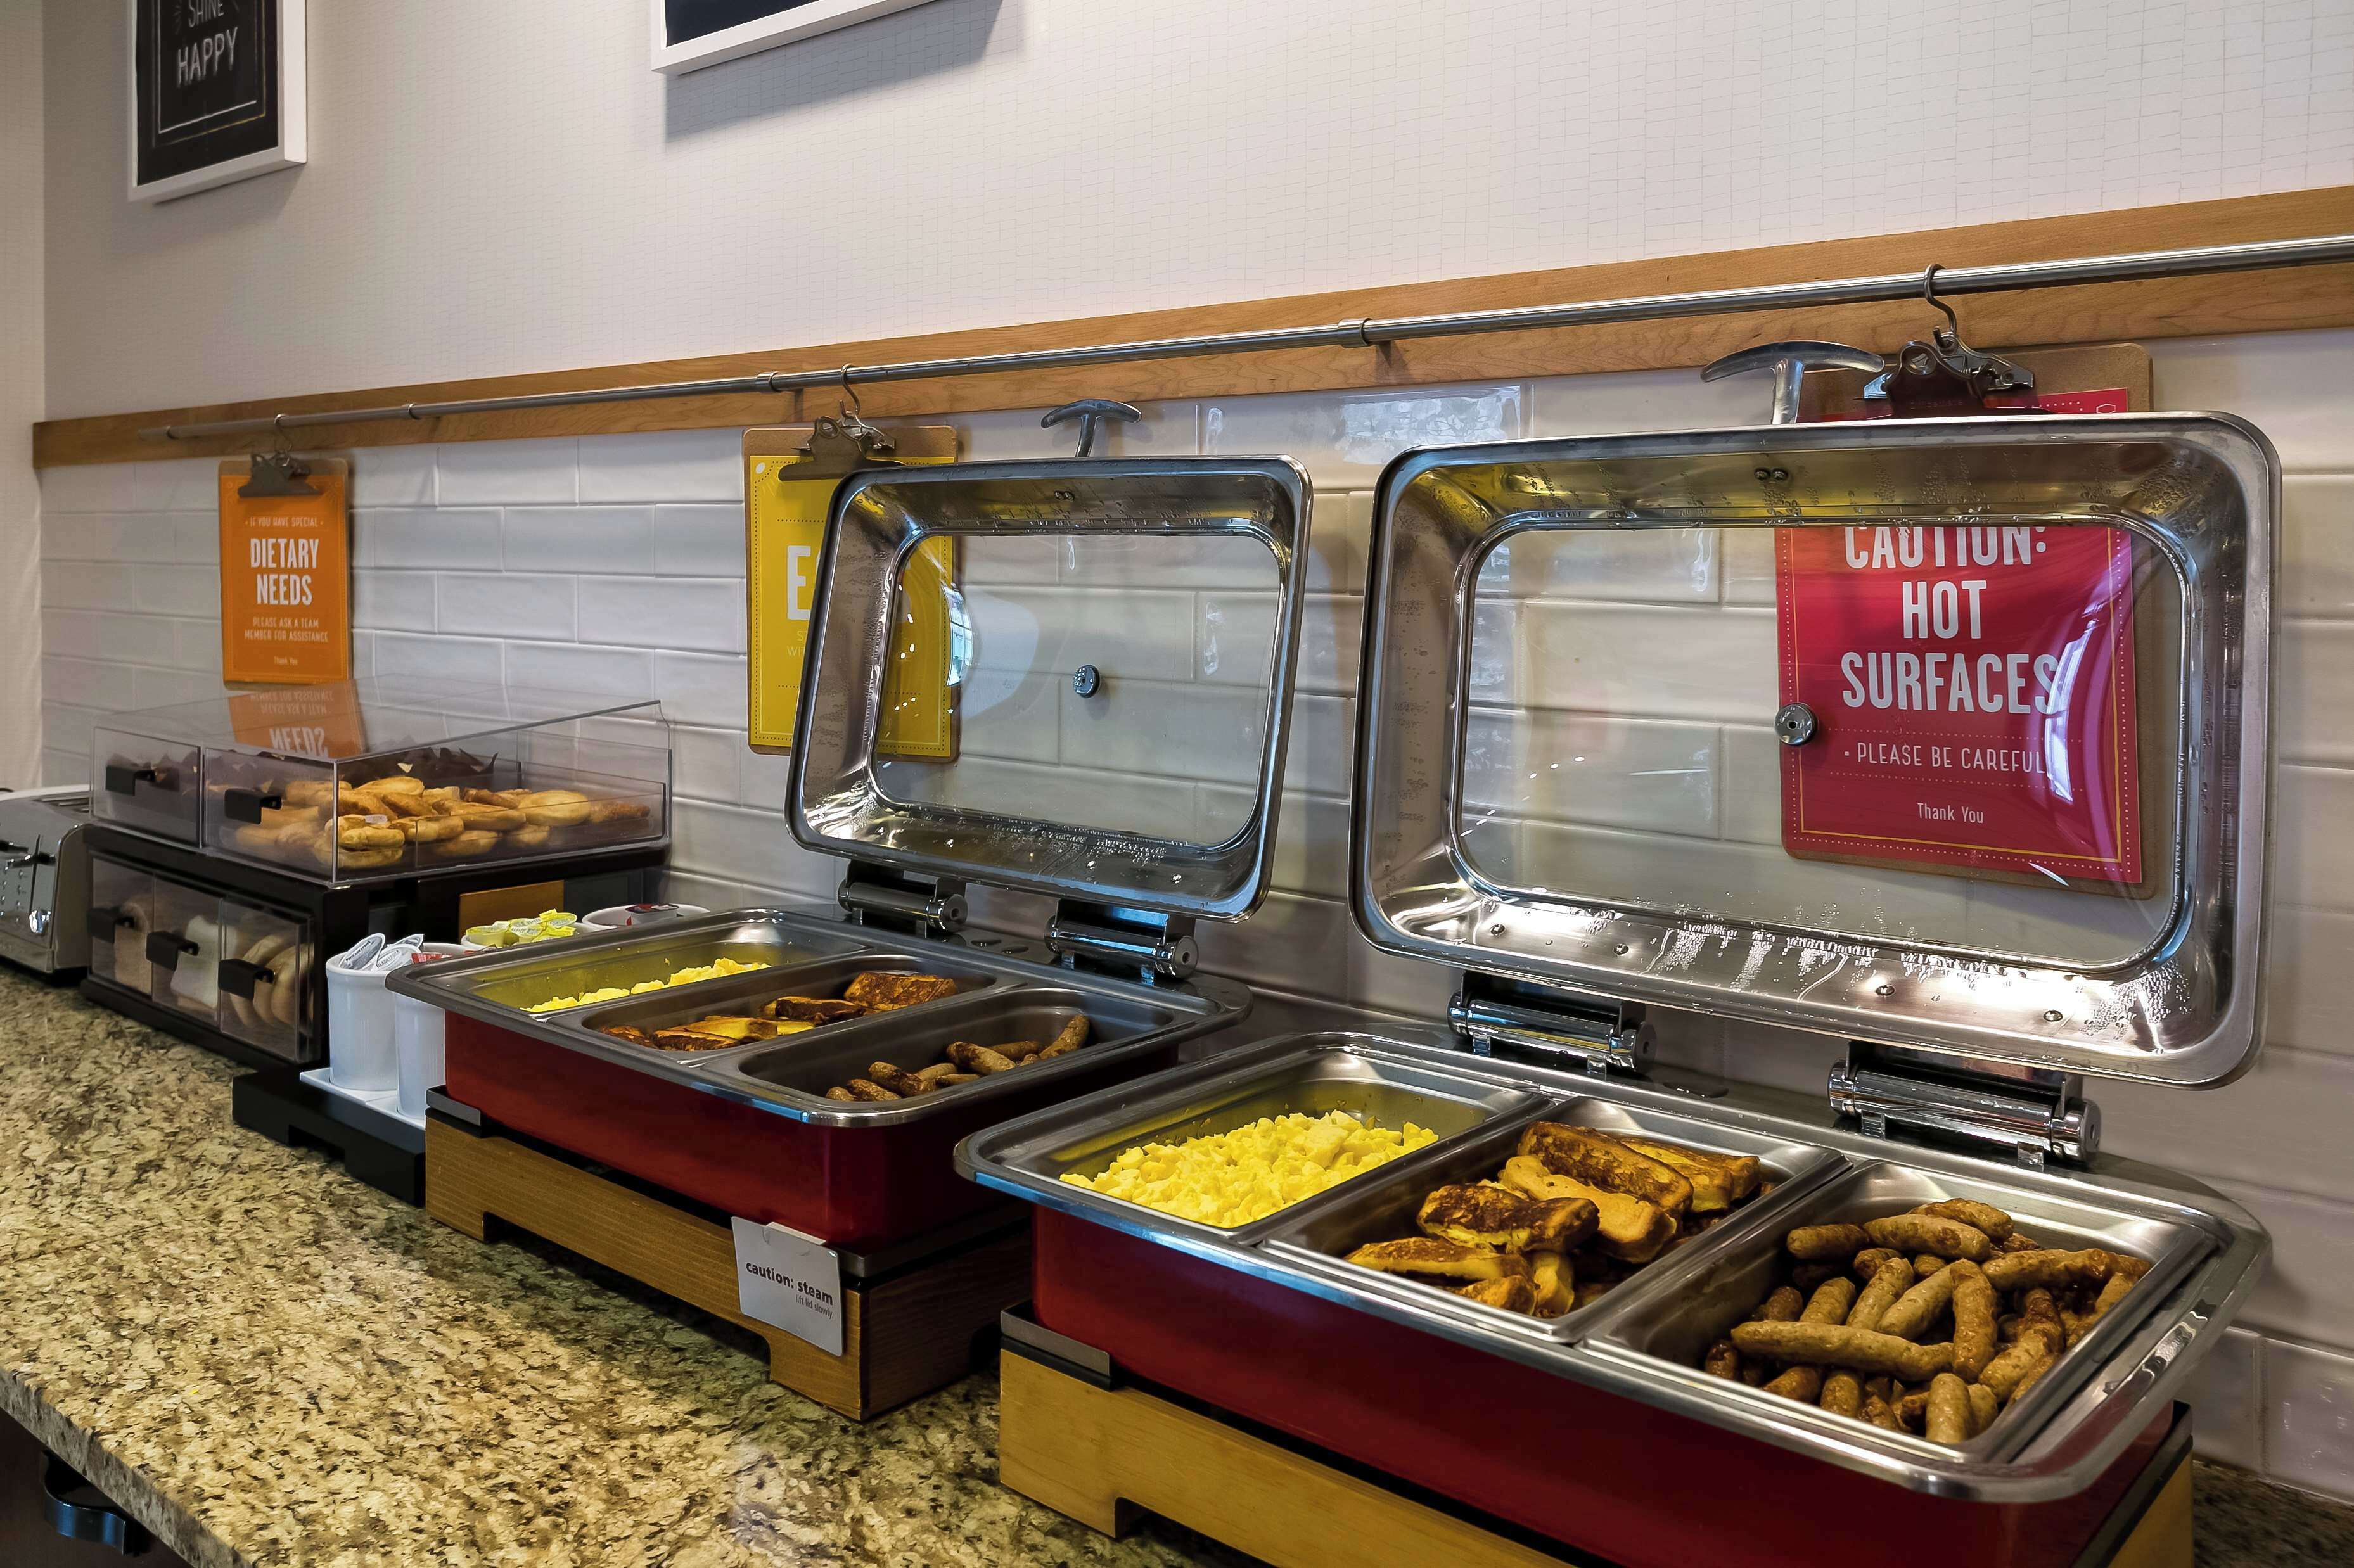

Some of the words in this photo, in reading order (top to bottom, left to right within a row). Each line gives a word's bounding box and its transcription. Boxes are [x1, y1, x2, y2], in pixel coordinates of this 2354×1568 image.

[188, 0, 224, 27] SHINE
[178, 27, 238, 87] HAPPY
[250, 516, 255, 527] IF
[259, 516, 271, 527] YOU
[273, 516, 289, 527] HAVE
[291, 516, 318, 528] SPECIAL
[250, 538, 319, 568] DIETARY
[1845, 526, 2047, 568] CAUTION:
[257, 573, 312, 606] NEEDS
[253, 617, 277, 628] PLEASE
[279, 618, 293, 628] ASK
[295, 618, 298, 628] A
[302, 618, 319, 629] TEAM
[1902, 580, 1987, 639] HOT
[245, 630, 272, 640] MEMBER
[274, 630, 286, 641] FOR
[289, 631, 329, 642] ASSISTANCE
[1841, 651, 2061, 715] SURFACES
[1857, 742, 1922, 767] PLEASE
[1931, 746, 1952, 768] BE
[1961, 748, 2046, 774] CAREFUL
[1917, 803, 1955, 822] Thank
[1961, 806, 1984, 824] You
[746, 1262, 795, 1289] caution:
[797, 1281, 833, 1306] steam
[795, 1293, 804, 1306] lift
